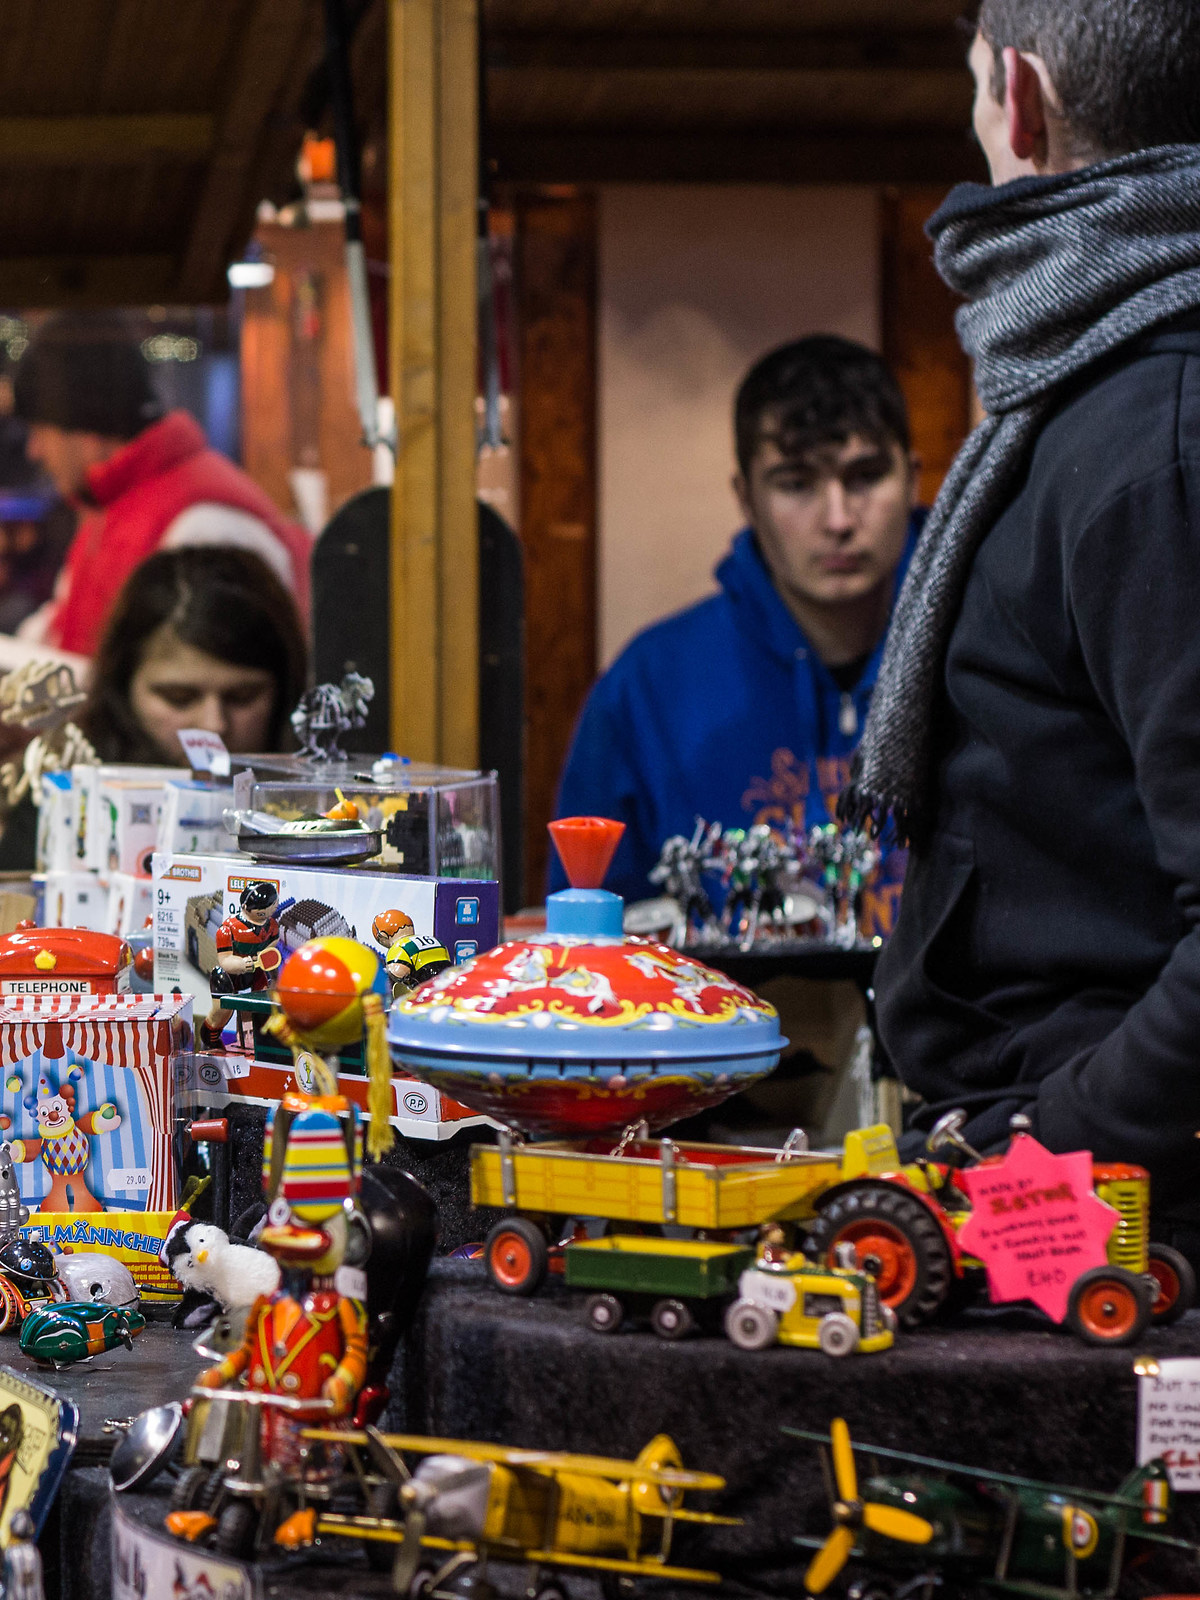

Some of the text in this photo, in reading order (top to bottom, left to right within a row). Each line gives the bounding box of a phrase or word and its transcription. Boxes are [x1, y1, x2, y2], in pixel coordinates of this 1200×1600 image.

[157, 889, 171, 905] 9+
[416, 936, 435, 947] 16
[9, 982, 87, 993] TELEPHONE
[126, 1175, 146, 1185] 29.00
